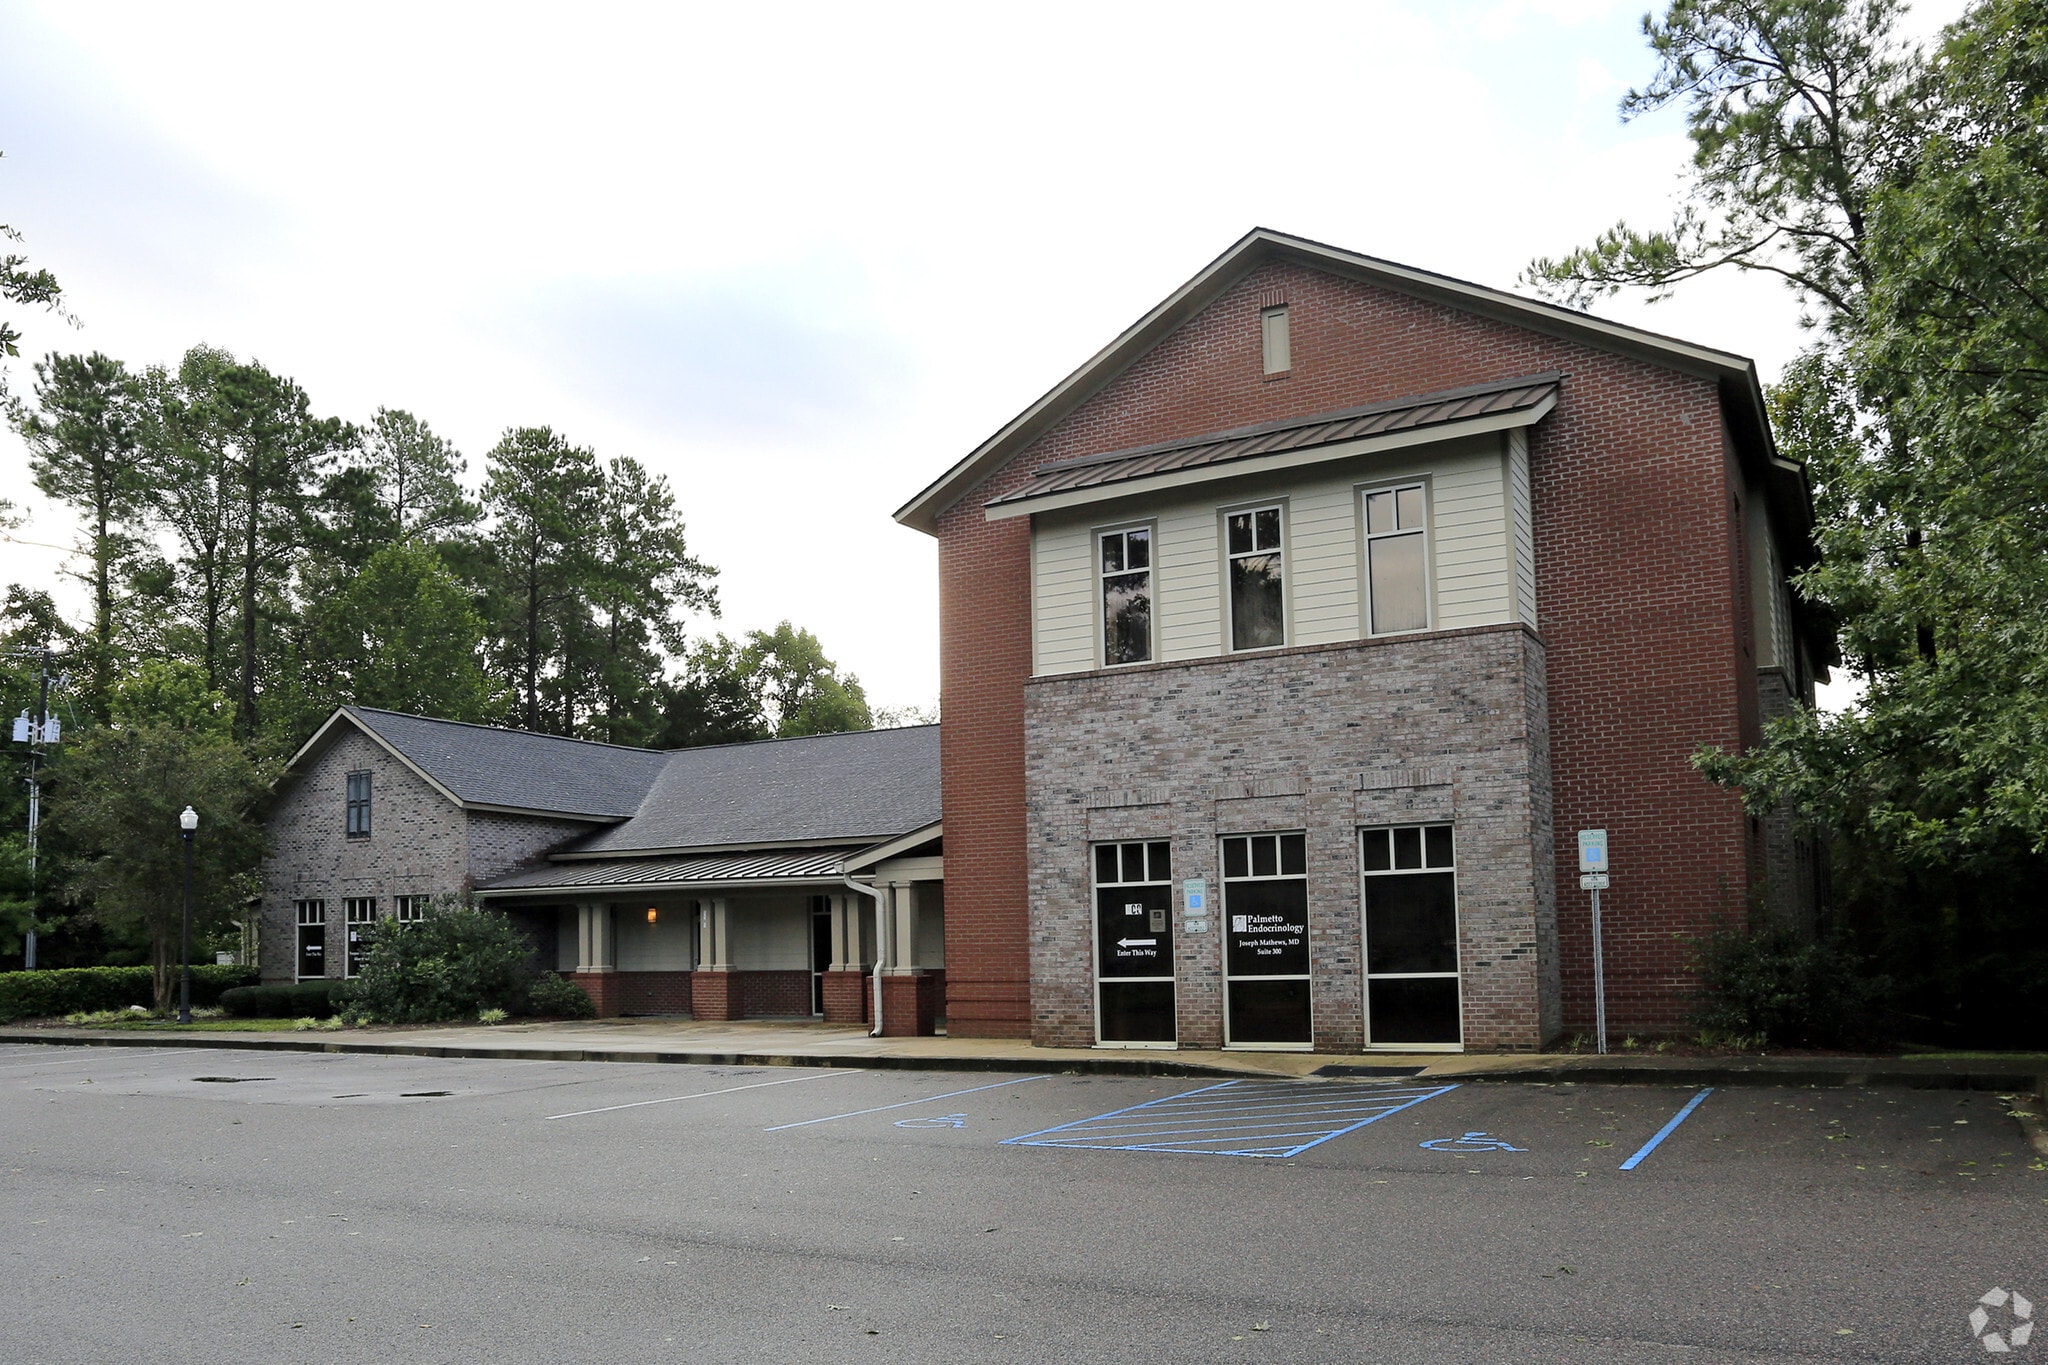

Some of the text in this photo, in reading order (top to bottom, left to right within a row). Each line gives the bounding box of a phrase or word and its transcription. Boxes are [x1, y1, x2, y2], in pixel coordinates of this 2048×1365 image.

[1248, 914, 1284, 923] Palmetto
[1248, 923, 1304, 934] Endocrinology
[1239, 940, 1258, 948] Joseph
[1144, 949, 1157, 958] Way
